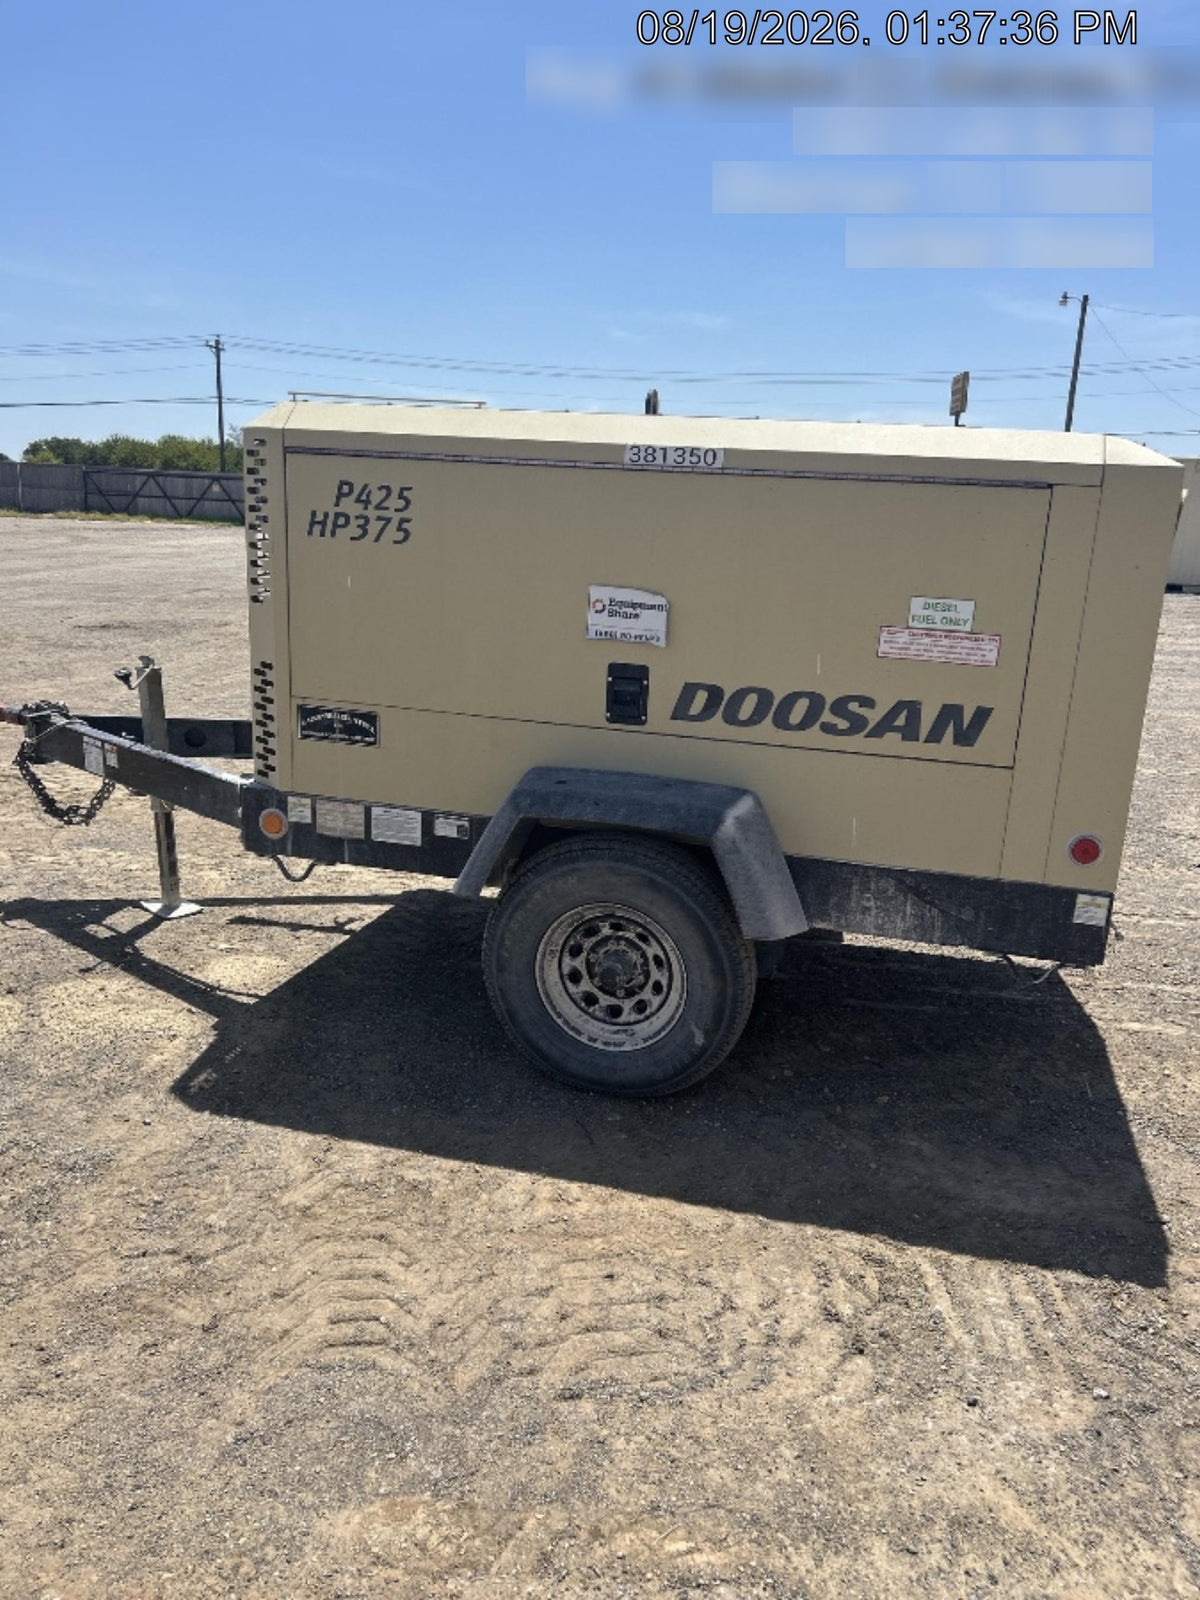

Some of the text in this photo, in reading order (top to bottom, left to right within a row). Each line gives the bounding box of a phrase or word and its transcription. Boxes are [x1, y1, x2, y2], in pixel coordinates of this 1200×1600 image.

[629, 446, 717, 467] 381350
[334, 480, 413, 512] P425
[307, 510, 413, 544] HP375
[607, 608, 640, 619] Share
[608, 597, 668, 612] Equipment
[922, 602, 960, 613] DIESEL
[911, 615, 970, 627] FUEL ONLY
[669, 682, 995, 747] DOOSAN
